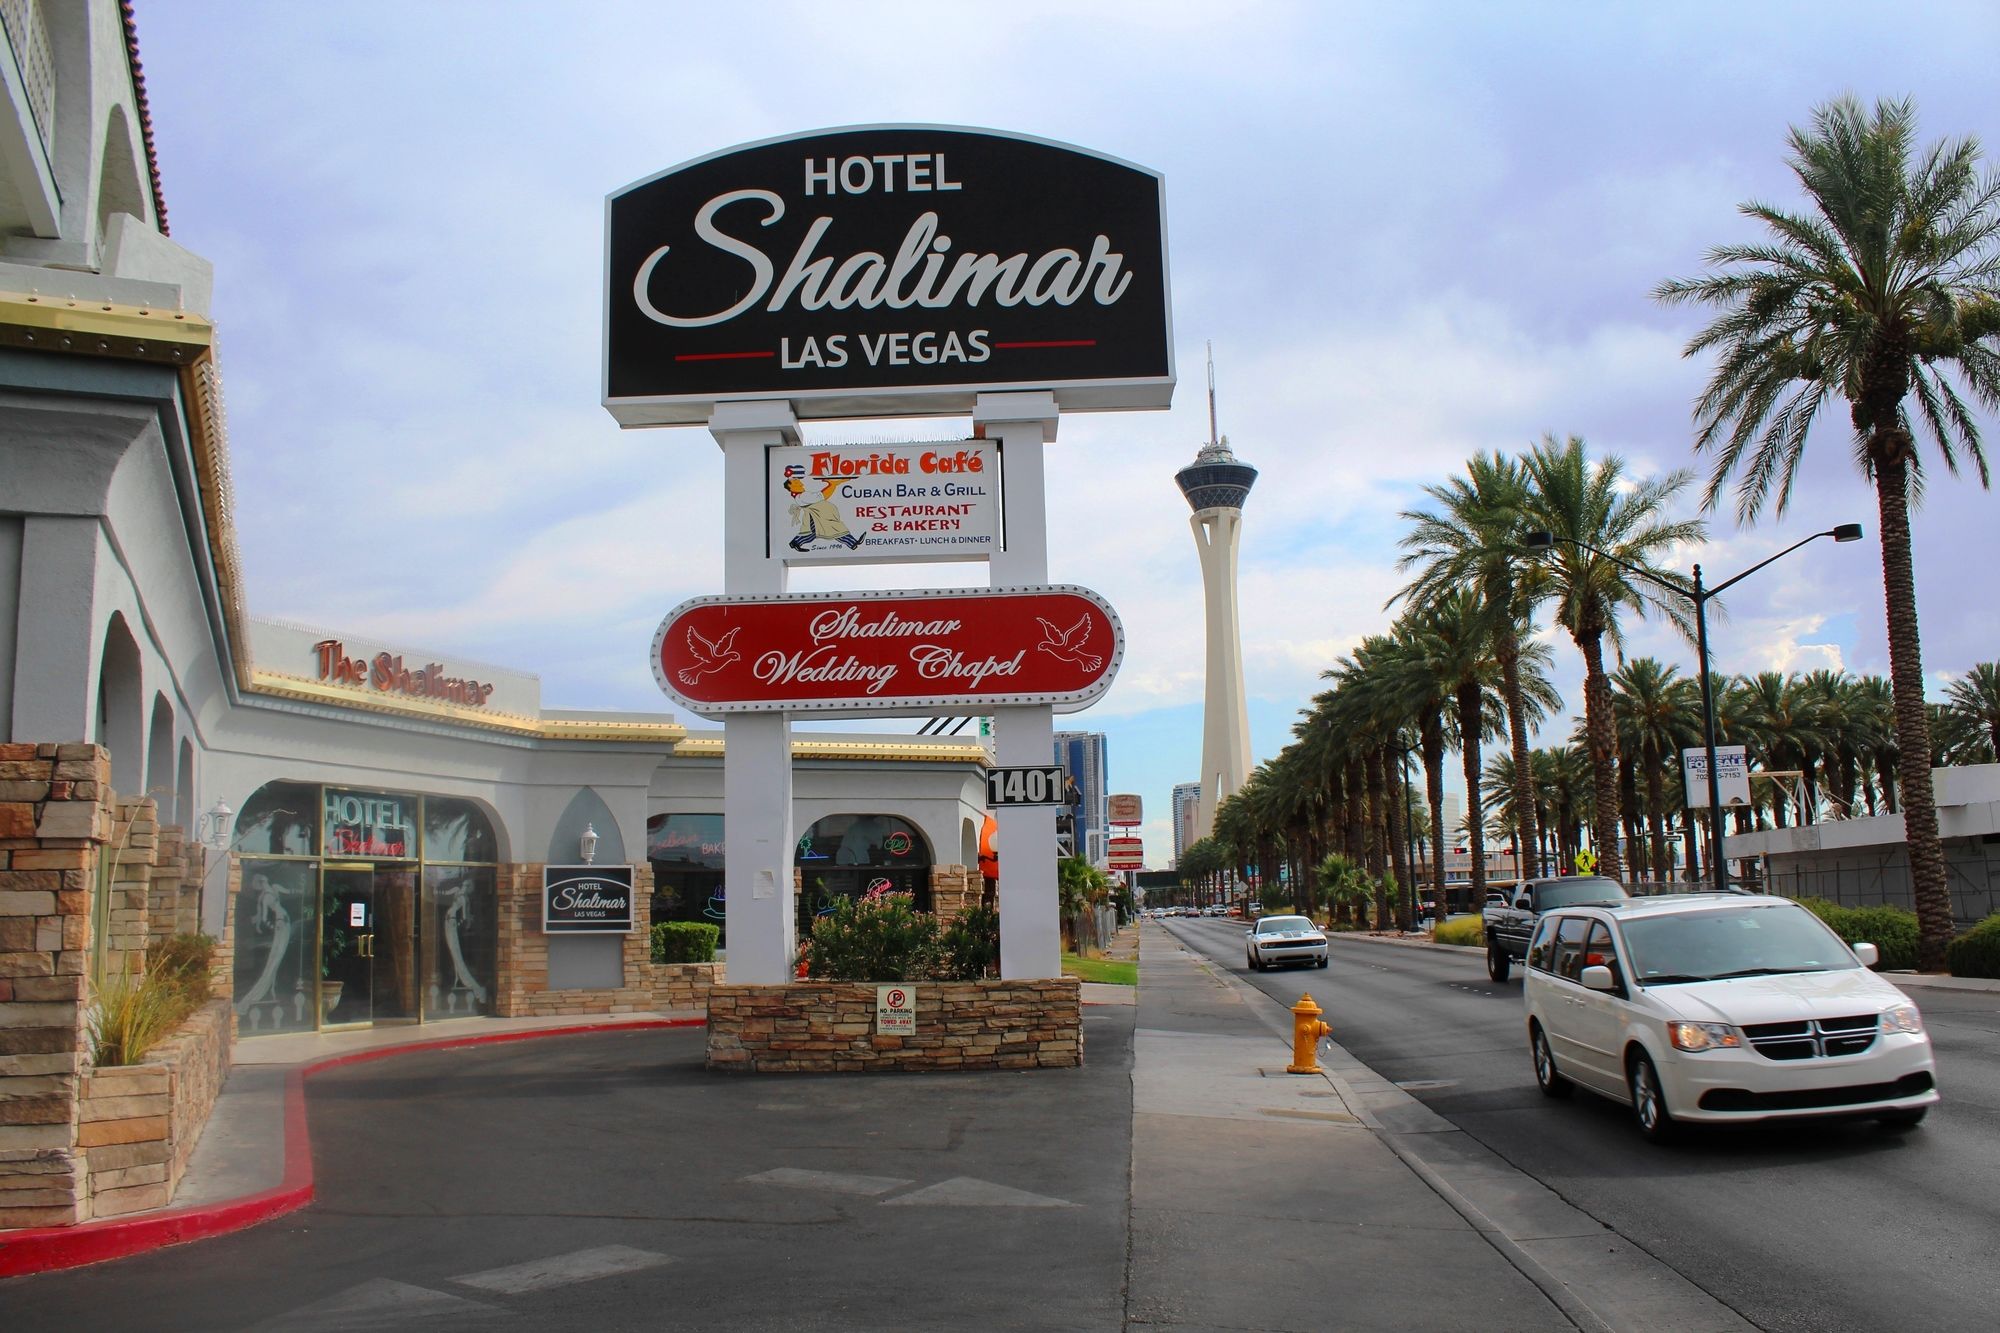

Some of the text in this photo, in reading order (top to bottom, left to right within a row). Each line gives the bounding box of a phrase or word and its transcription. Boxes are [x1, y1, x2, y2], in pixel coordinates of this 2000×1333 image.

[804, 152, 962, 196] HOTEL
[633, 189, 1134, 328] Shalimar
[780, 329, 991, 369] LAS VEGAS
[808, 450, 984, 476] Florida Café
[842, 482, 986, 498] CUBAN BAR & GRILL
[856, 503, 977, 519] RESTAURANT
[871, 519, 960, 532] & BAKERY
[920, 536, 950, 545] LUNCH
[950, 536, 957, 544] &
[958, 535, 991, 544] DINNER
[809, 606, 962, 646] Shalimar
[313, 639, 494, 706] The Shalimar
[753, 644, 1024, 694] Wedding Chapel
[1716, 759, 1745, 767] SALE
[989, 769, 1063, 803] 1401
[325, 794, 409, 830] HOTEL
[552, 887, 627, 911] Shalimar
[578, 882, 603, 891] HOTEL
